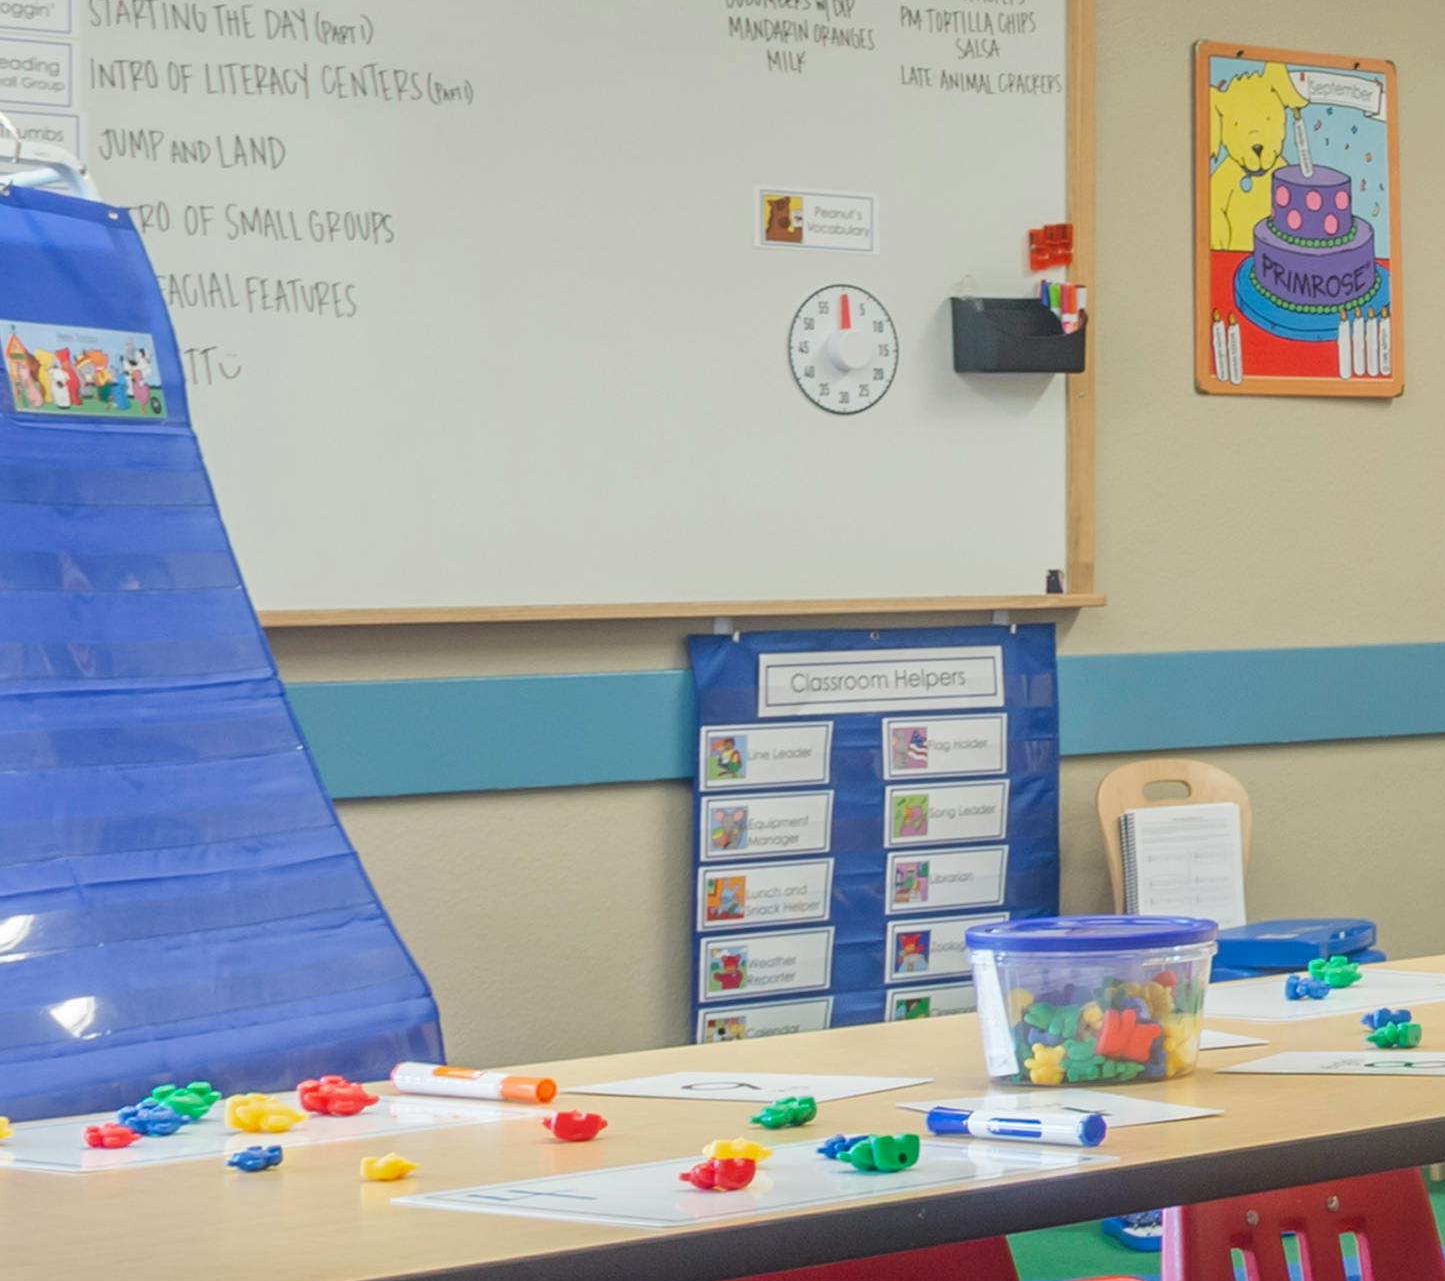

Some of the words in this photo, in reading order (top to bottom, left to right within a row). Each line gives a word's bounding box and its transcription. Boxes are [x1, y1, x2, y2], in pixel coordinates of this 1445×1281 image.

[212, 4, 256, 39] THE
[265, 9, 309, 44] DAY
[766, 49, 807, 74] MILK
[22, 76, 65, 93] Group
[90, 57, 159, 92] INTRO
[167, 60, 193, 95] OF
[204, 63, 311, 100] LITERACY
[321, 64, 424, 103] CENTERS
[1309, 78, 1374, 102] September
[99, 128, 164, 162] JUMP
[171, 139, 212, 165] AND
[216, 134, 287, 170] LAND
[183, 205, 215, 237] OF
[225, 203, 305, 243] SMALL
[308, 209, 395, 245] GROUPS
[813, 205, 863, 222] Peanut's
[806, 219, 870, 238] Vocabulary
[1261, 252, 1368, 297] PRIMROSE
[245, 276, 358, 319] FEATURES
[790, 670, 889, 694] Classroom
[894, 667, 967, 692] Helpers
[773, 746, 812, 760] Leader
[958, 804, 996, 817] Leader
[748, 833, 800, 850] Manager
[748, 955, 797, 969] Weather
[748, 971, 796, 986] Reporter
